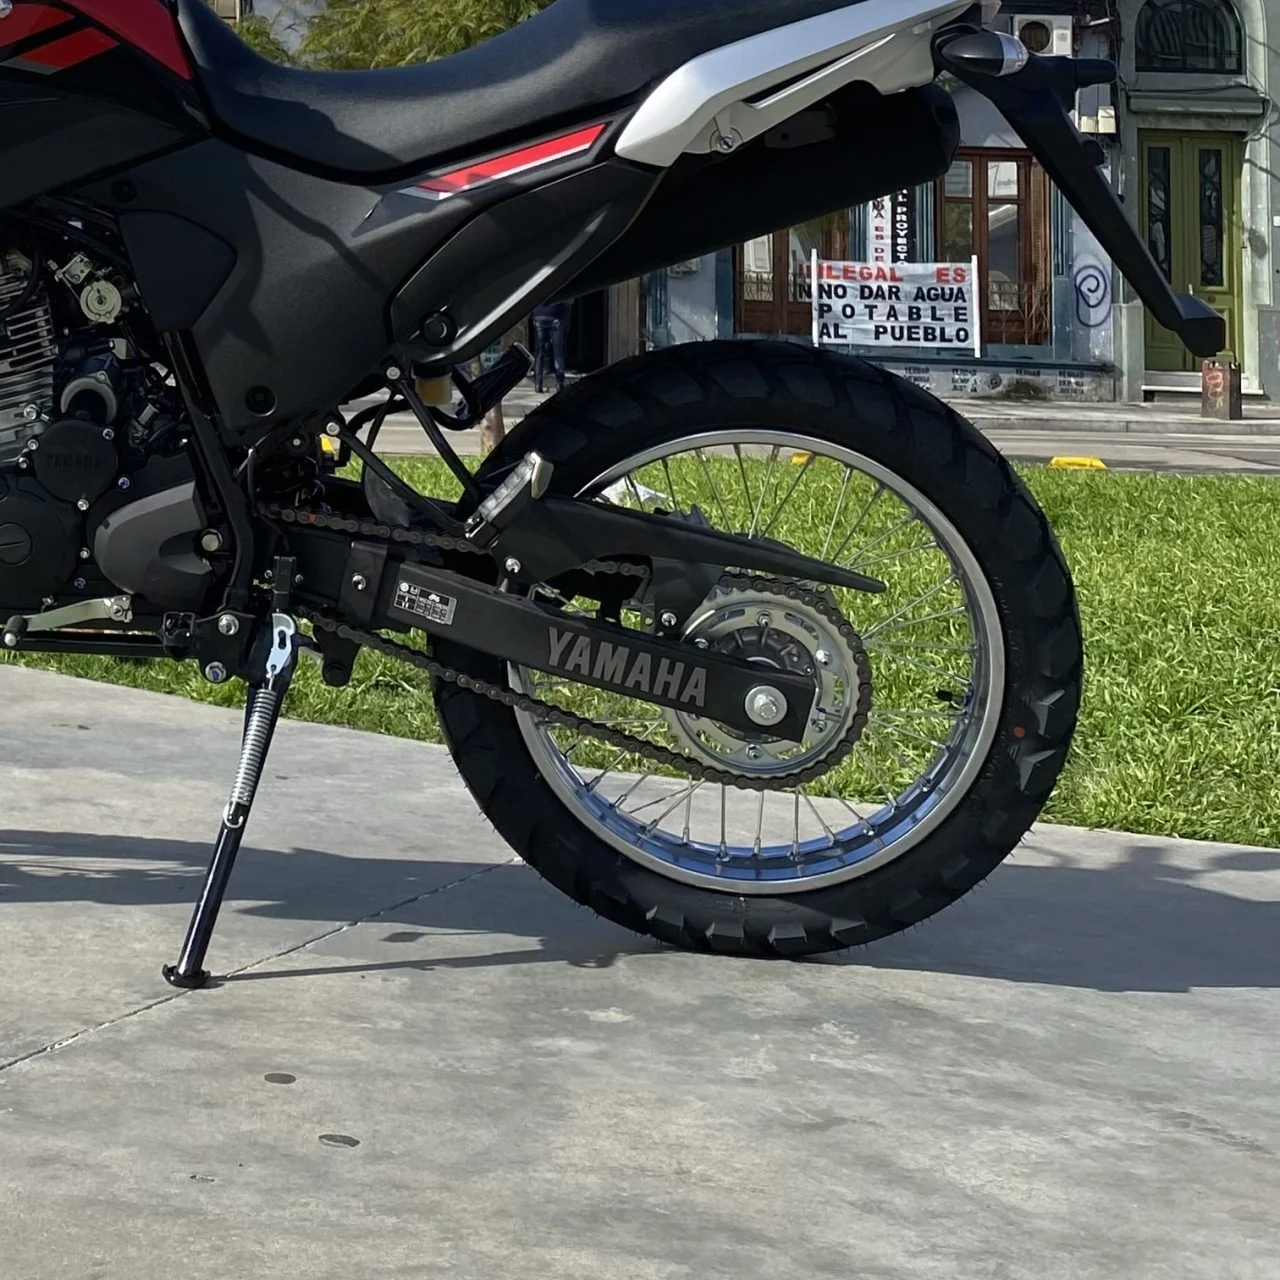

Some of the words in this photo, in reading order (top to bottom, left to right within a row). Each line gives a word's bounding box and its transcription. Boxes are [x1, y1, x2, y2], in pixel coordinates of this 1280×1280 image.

[935, 267, 966, 283] ES
[818, 283, 847, 299] NO
[859, 285, 902, 301] DAR
[913, 286, 967, 303] AGUA
[818, 303, 969, 323] POTABLE
[819, 322, 847, 339] AL
[874, 325, 970, 343] PUEBLO
[548, 626, 707, 707] YAMAHA
